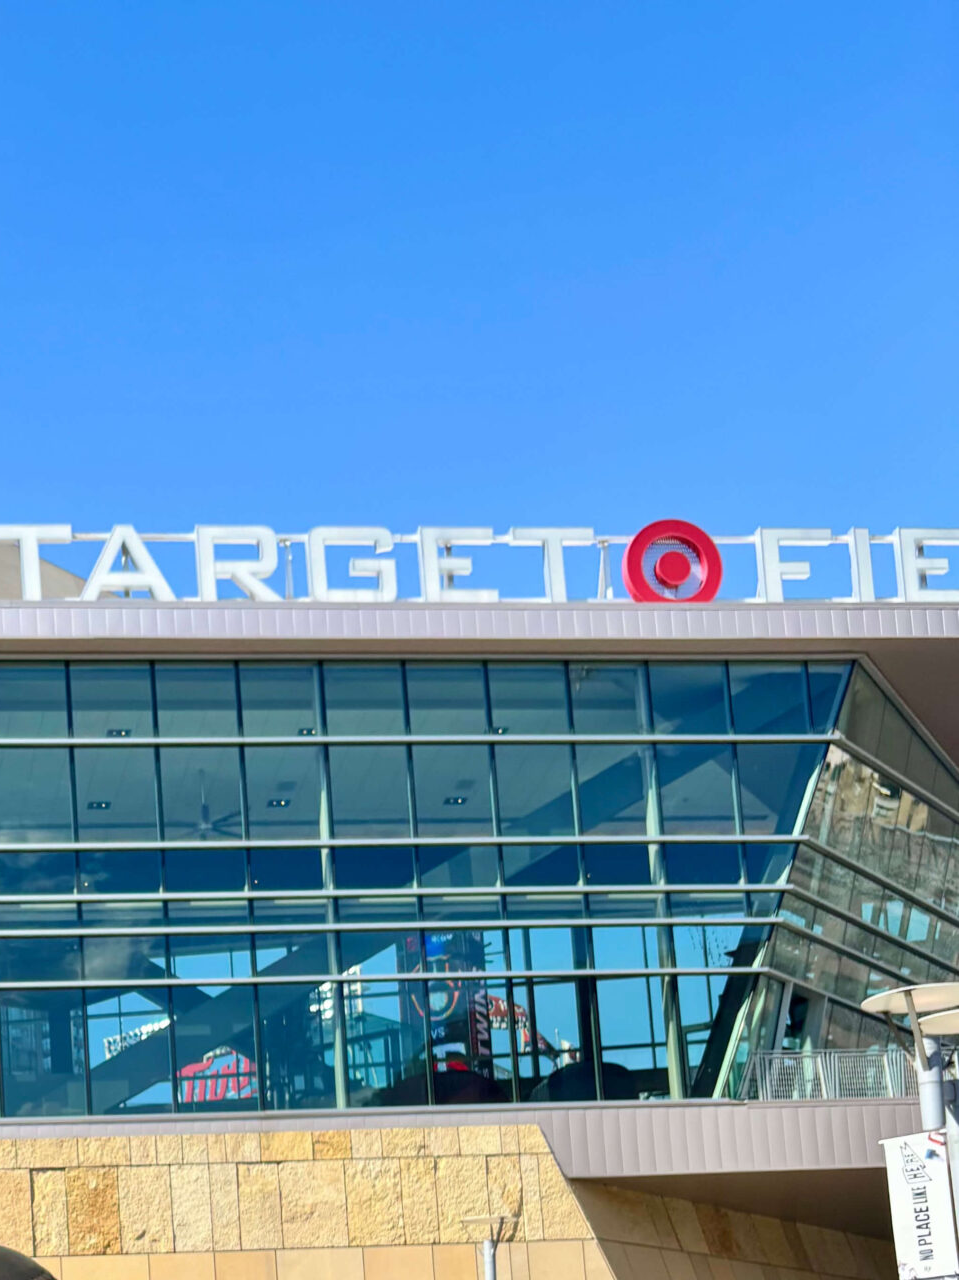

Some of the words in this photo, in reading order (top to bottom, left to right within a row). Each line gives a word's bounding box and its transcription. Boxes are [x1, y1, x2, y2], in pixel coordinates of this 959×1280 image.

[911, 1186, 928, 1205] LIKE
[914, 1206, 933, 1247] PLACE
[919, 1248, 934, 1262] NO
